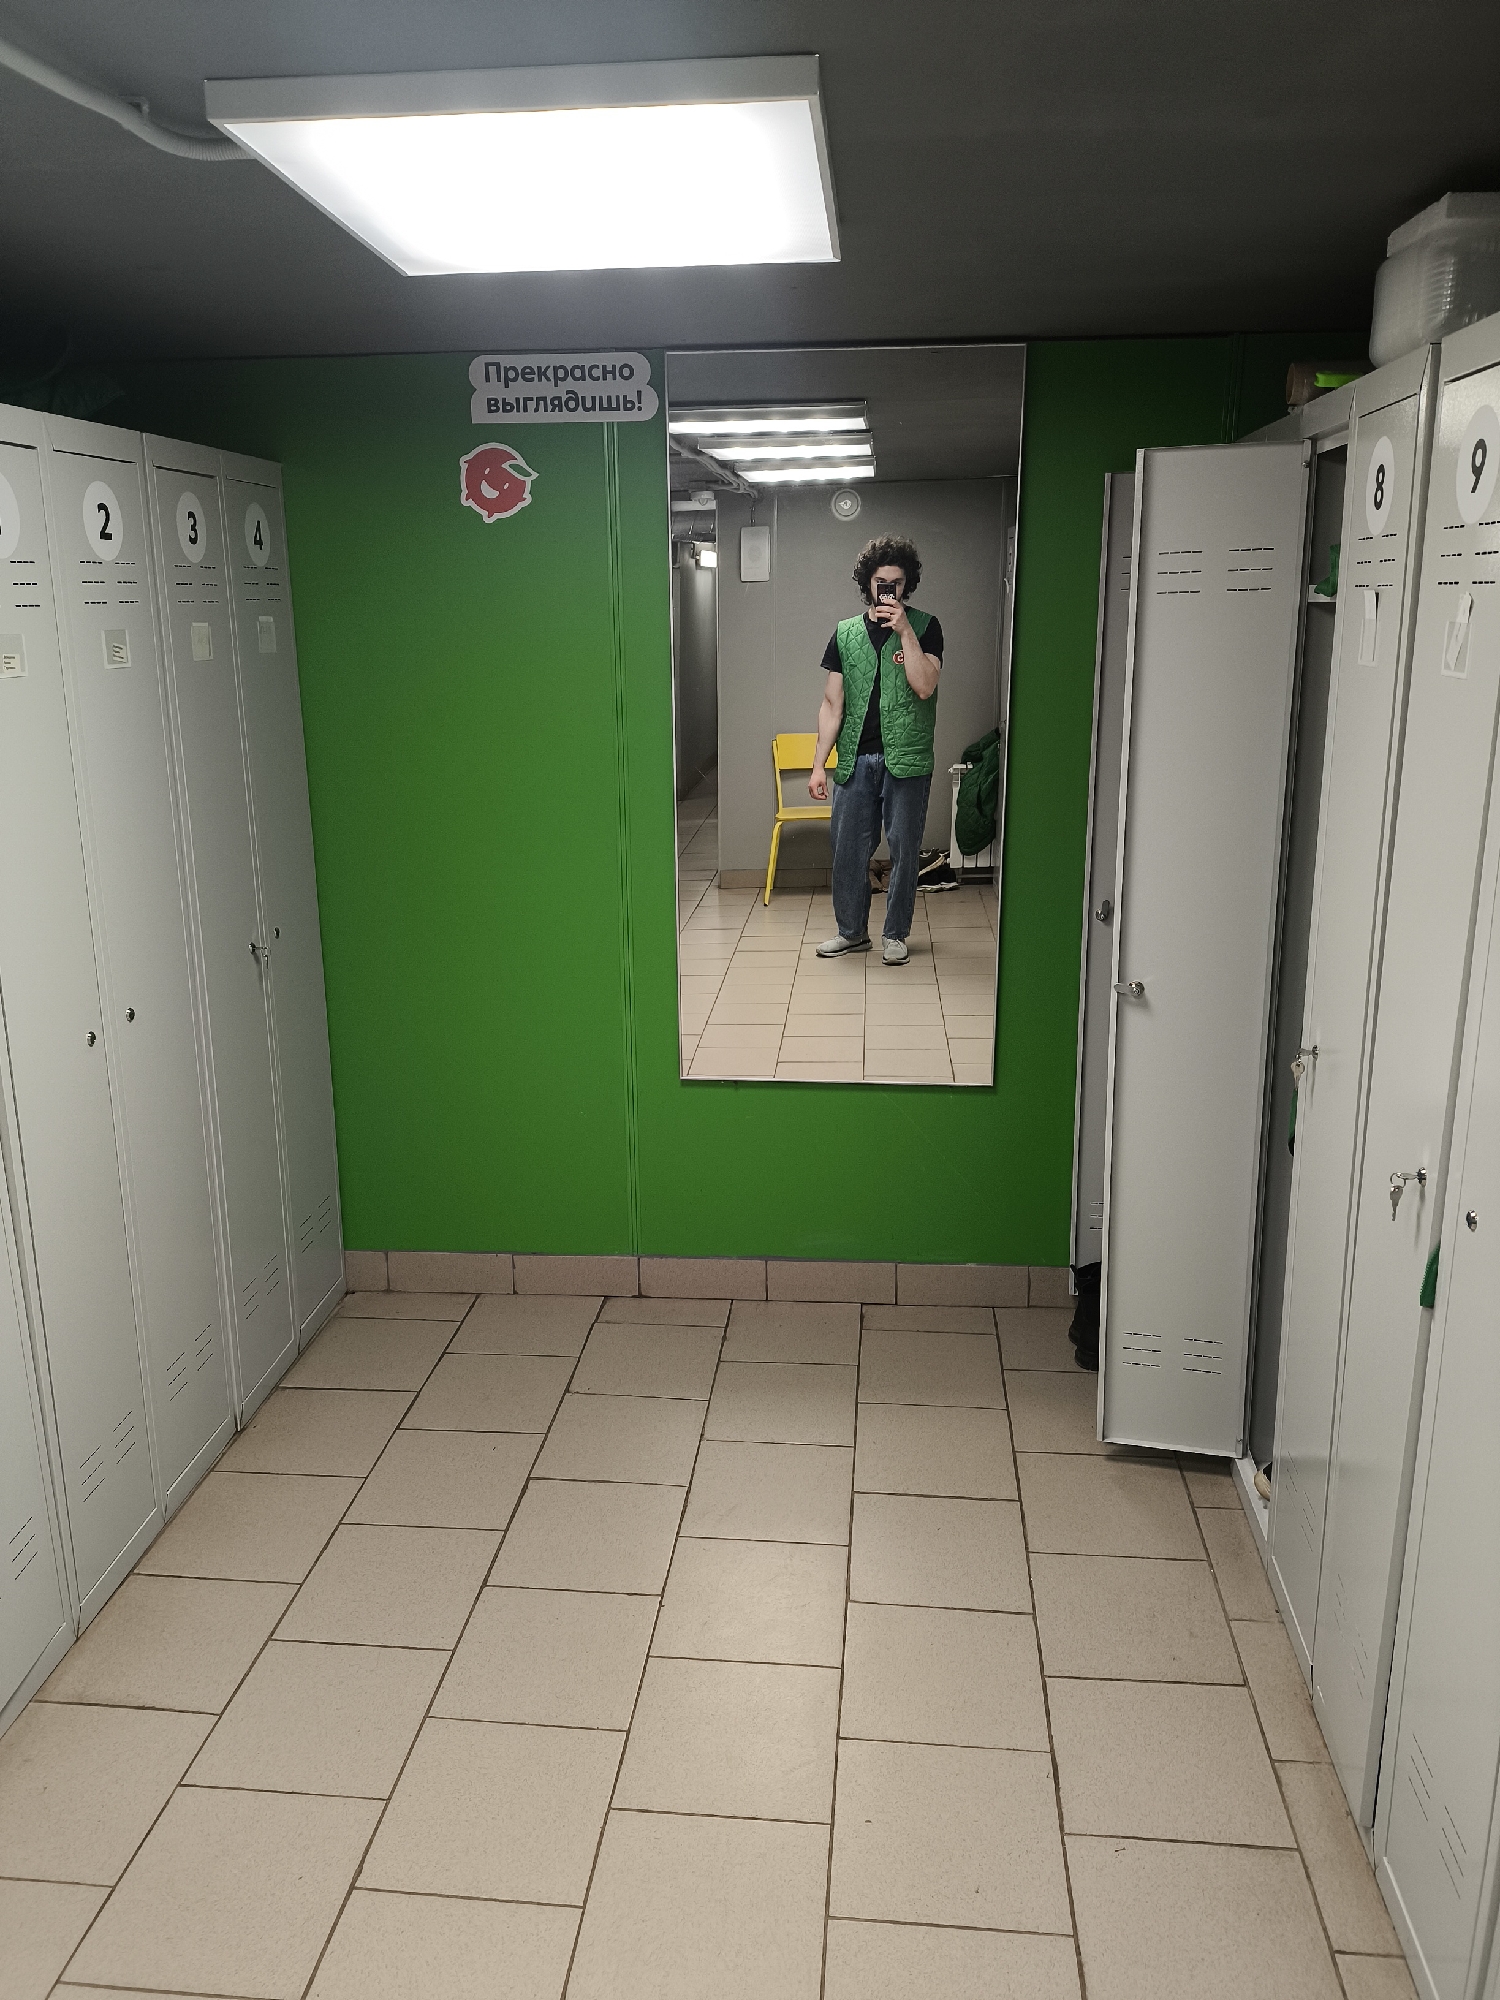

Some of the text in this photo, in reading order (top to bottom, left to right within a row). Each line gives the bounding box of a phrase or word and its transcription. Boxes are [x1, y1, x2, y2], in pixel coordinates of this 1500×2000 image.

[484, 362, 635, 388] Прекрасно
[486, 390, 643, 413] выглядишь!
[1471, 438, 1487, 493] 9
[1374, 463, 1385, 510] 8
[97, 503, 112, 540] 2
[187, 511, 198, 544] 3
[254, 520, 263, 550] 4
